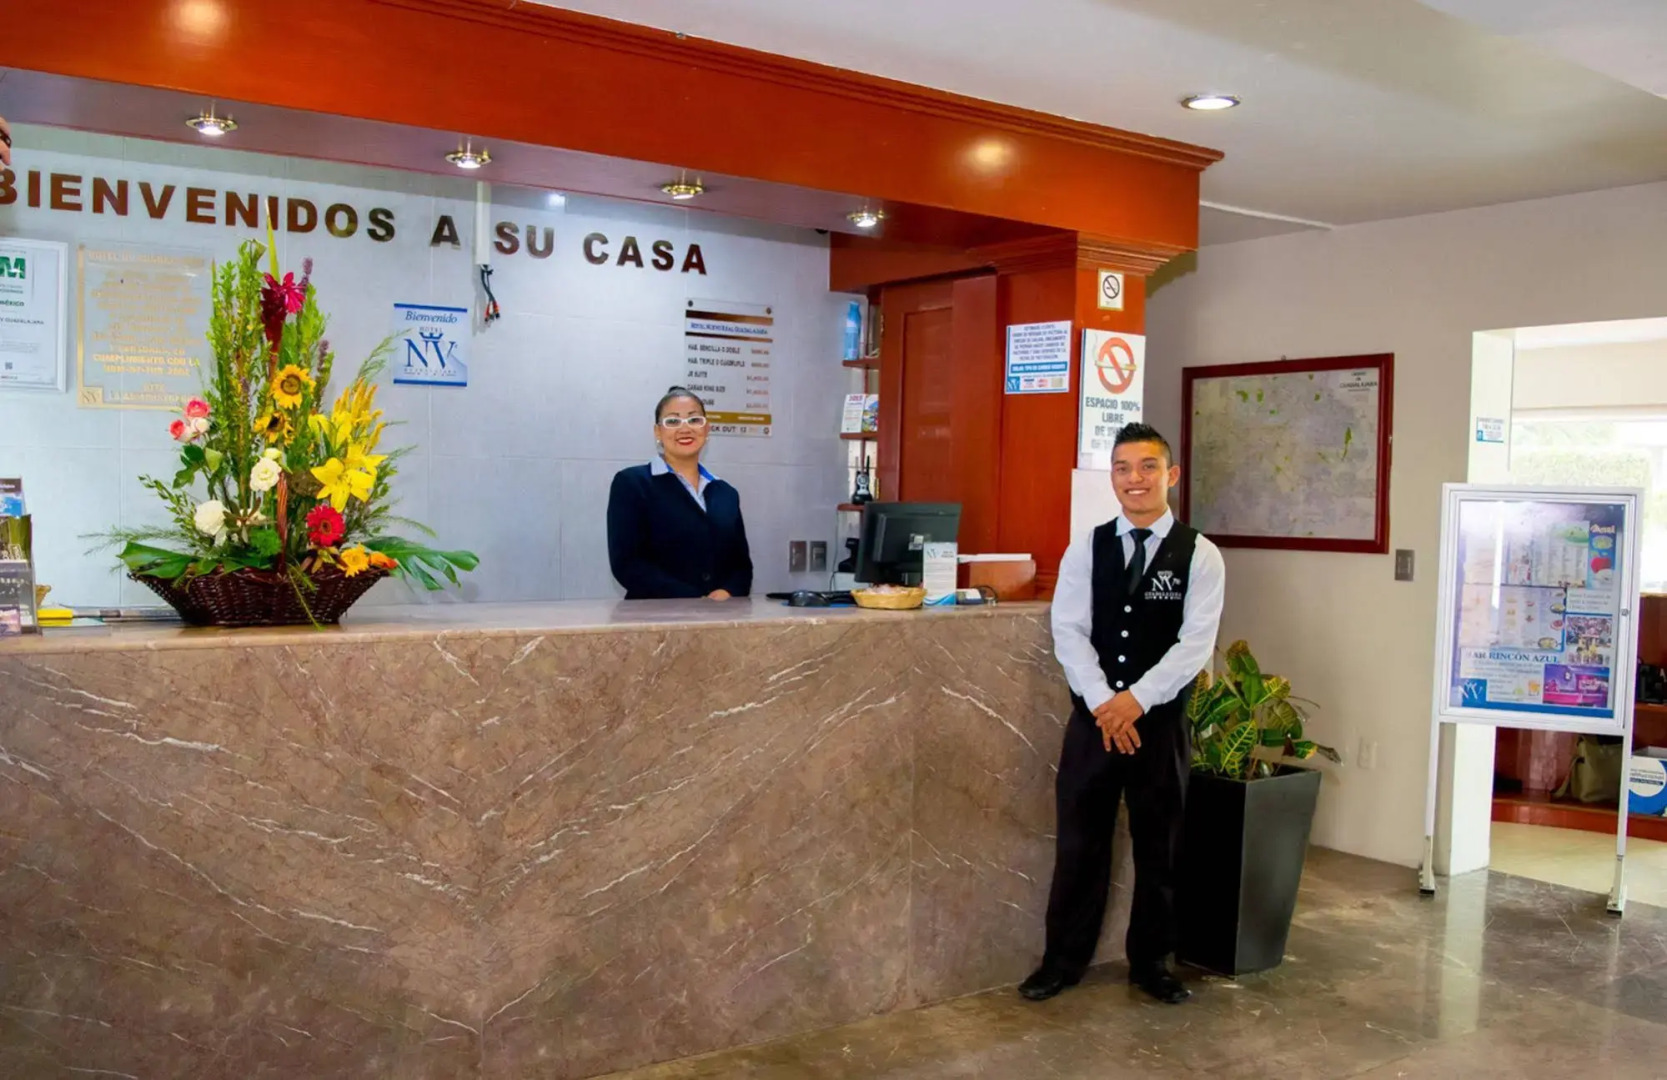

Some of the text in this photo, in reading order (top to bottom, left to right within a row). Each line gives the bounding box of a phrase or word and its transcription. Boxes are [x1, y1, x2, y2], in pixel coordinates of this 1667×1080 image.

[430, 214, 460, 248] A
[493, 221, 555, 259] SU
[583, 232, 708, 276] CASA
[405, 310, 458, 323] Bienvenido
[404, 338, 457, 369] NV
[1085, 397, 1140, 411] ESPACIO 100%
[1102, 412, 1124, 424] LIBRE
[1489, 651, 1529, 661] RINCÓN
